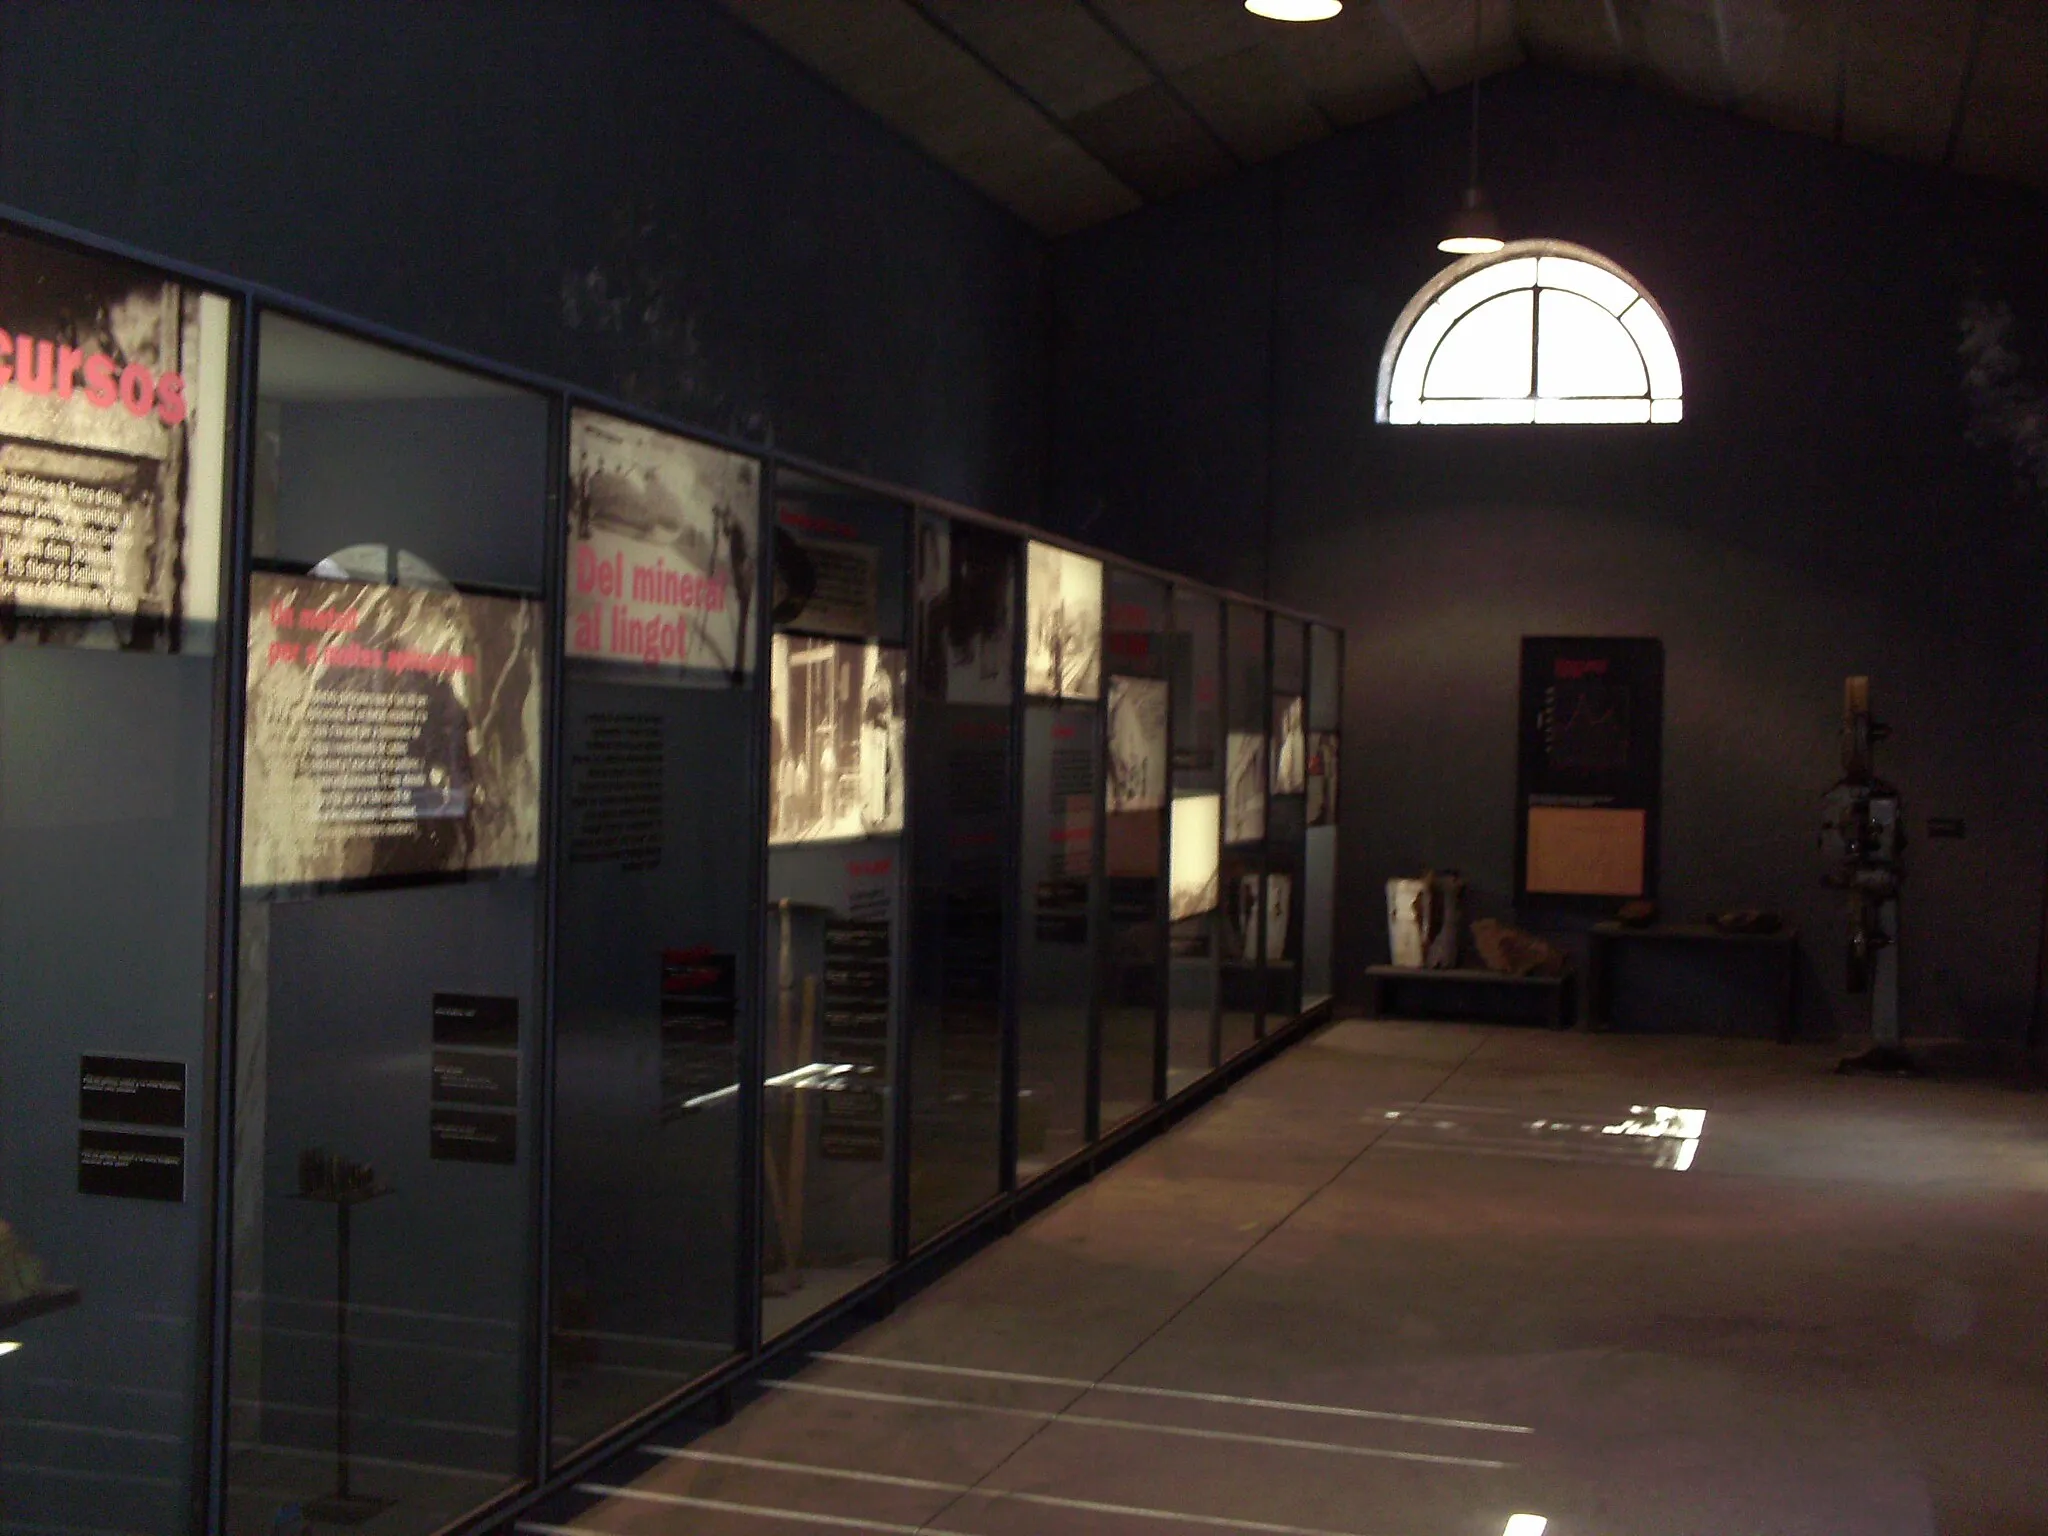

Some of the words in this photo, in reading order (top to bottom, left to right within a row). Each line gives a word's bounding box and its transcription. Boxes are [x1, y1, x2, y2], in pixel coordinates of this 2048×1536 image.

[575, 544, 623, 599] Del
[632, 560, 727, 612] mineral
[573, 602, 602, 650] al
[611, 606, 687, 668] lingot
